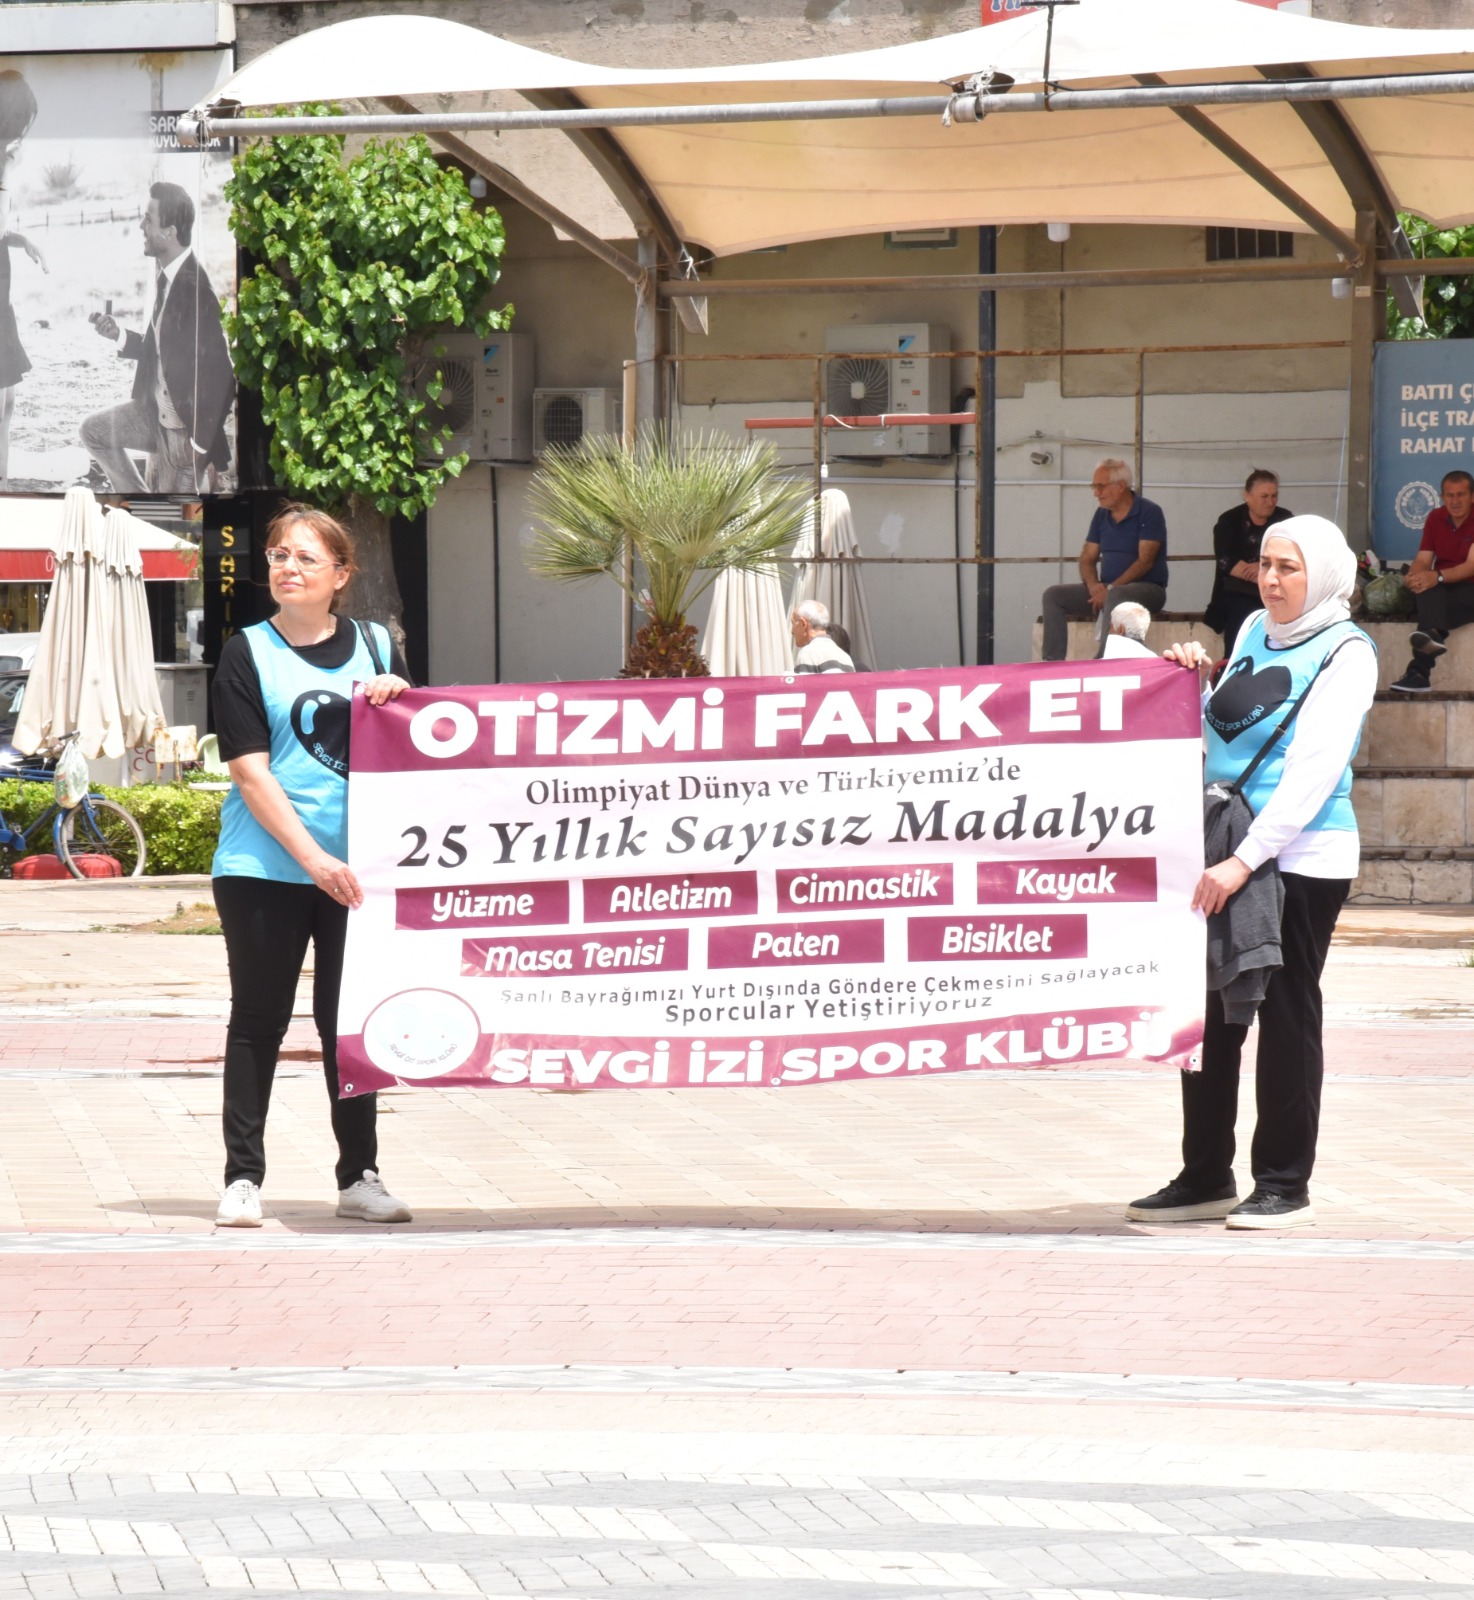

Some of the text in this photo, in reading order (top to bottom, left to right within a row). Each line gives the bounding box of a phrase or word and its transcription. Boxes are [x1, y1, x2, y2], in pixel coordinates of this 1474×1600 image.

[1401, 382, 1474, 404] BATTI Ç
[1400, 408, 1439, 431] İLÇE
[1400, 437, 1465, 454] RAHAT
[755, 683, 1003, 748] FARK
[1029, 675, 1141, 733] ET
[526, 778, 671, 811] Olimpiyat
[678, 775, 771, 806] Dünya
[779, 778, 808, 796] ve
[397, 791, 1156, 868] 25 Yıllık Sayısız Madalya
[431, 865, 1117, 922] Yüzme Atletizm Cimnastik Kayak
[484, 923, 1053, 972] Masa Tenisi Paten Bisiklet
[500, 961, 1159, 1006] Şanlı Bayrağımızı Yurt Dışında Göndere Çekmesini Sağlayacak
[665, 996, 993, 1026] Sporcular Yetiştiriyoruz
[491, 1011, 1172, 1084] SEVGİ İZİ SPOR KLÜBÜ
